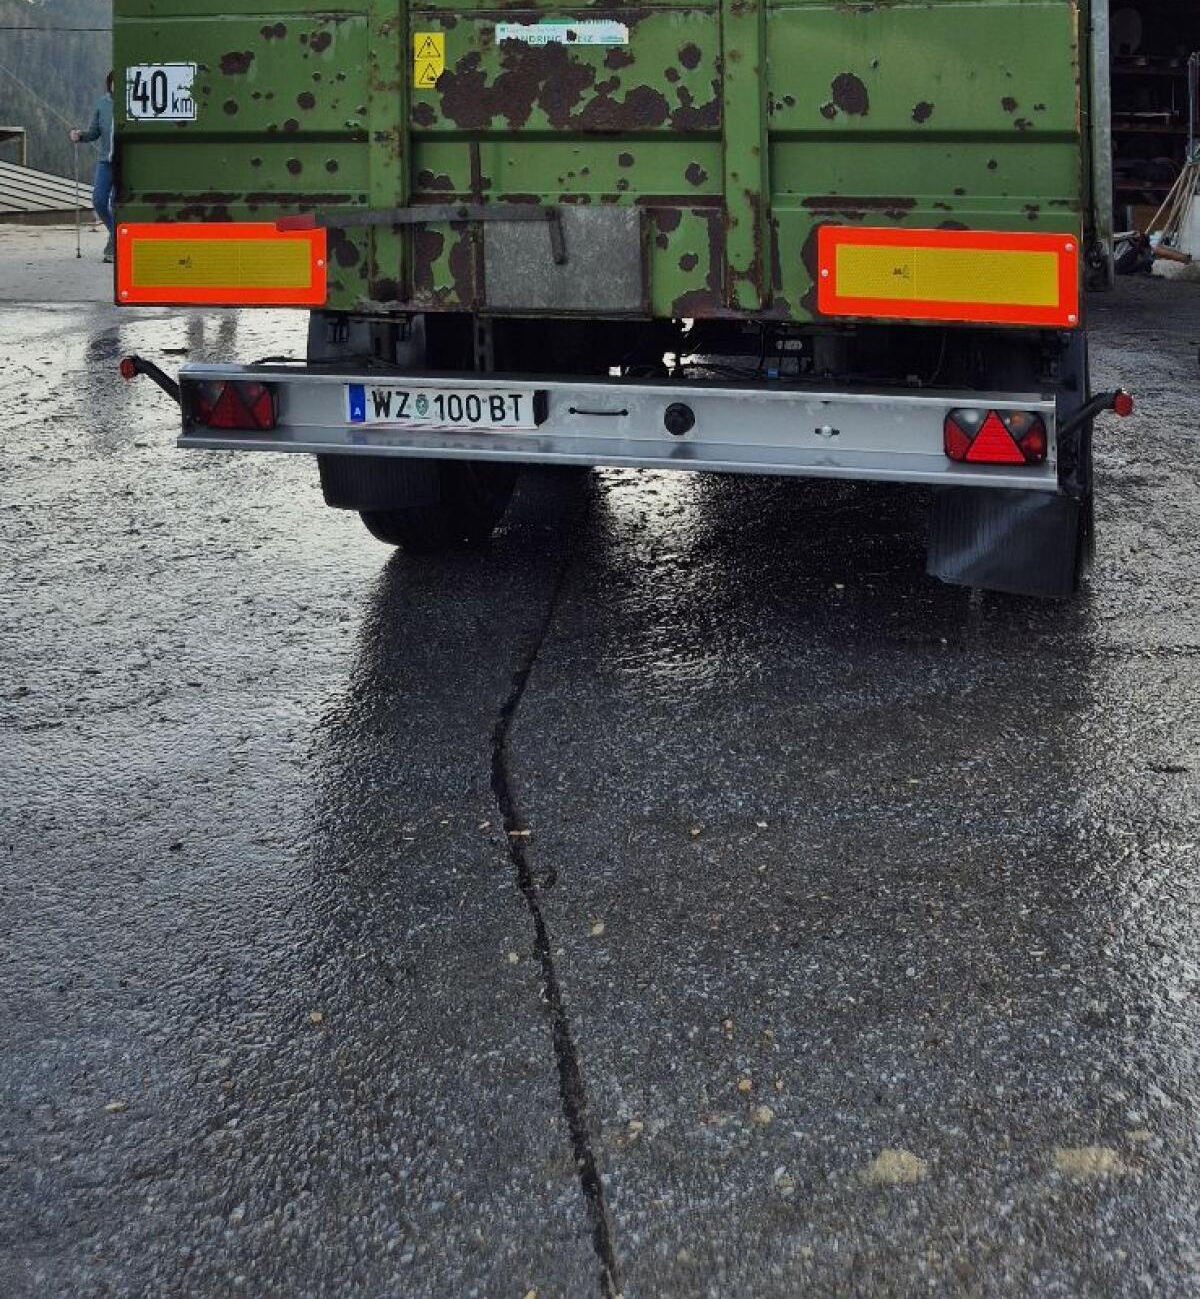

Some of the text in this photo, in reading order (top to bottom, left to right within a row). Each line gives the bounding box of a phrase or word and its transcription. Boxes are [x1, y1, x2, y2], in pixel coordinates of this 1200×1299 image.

[133, 70, 192, 114] 40 km
[371, 390, 523, 423] WZ 100 BT
